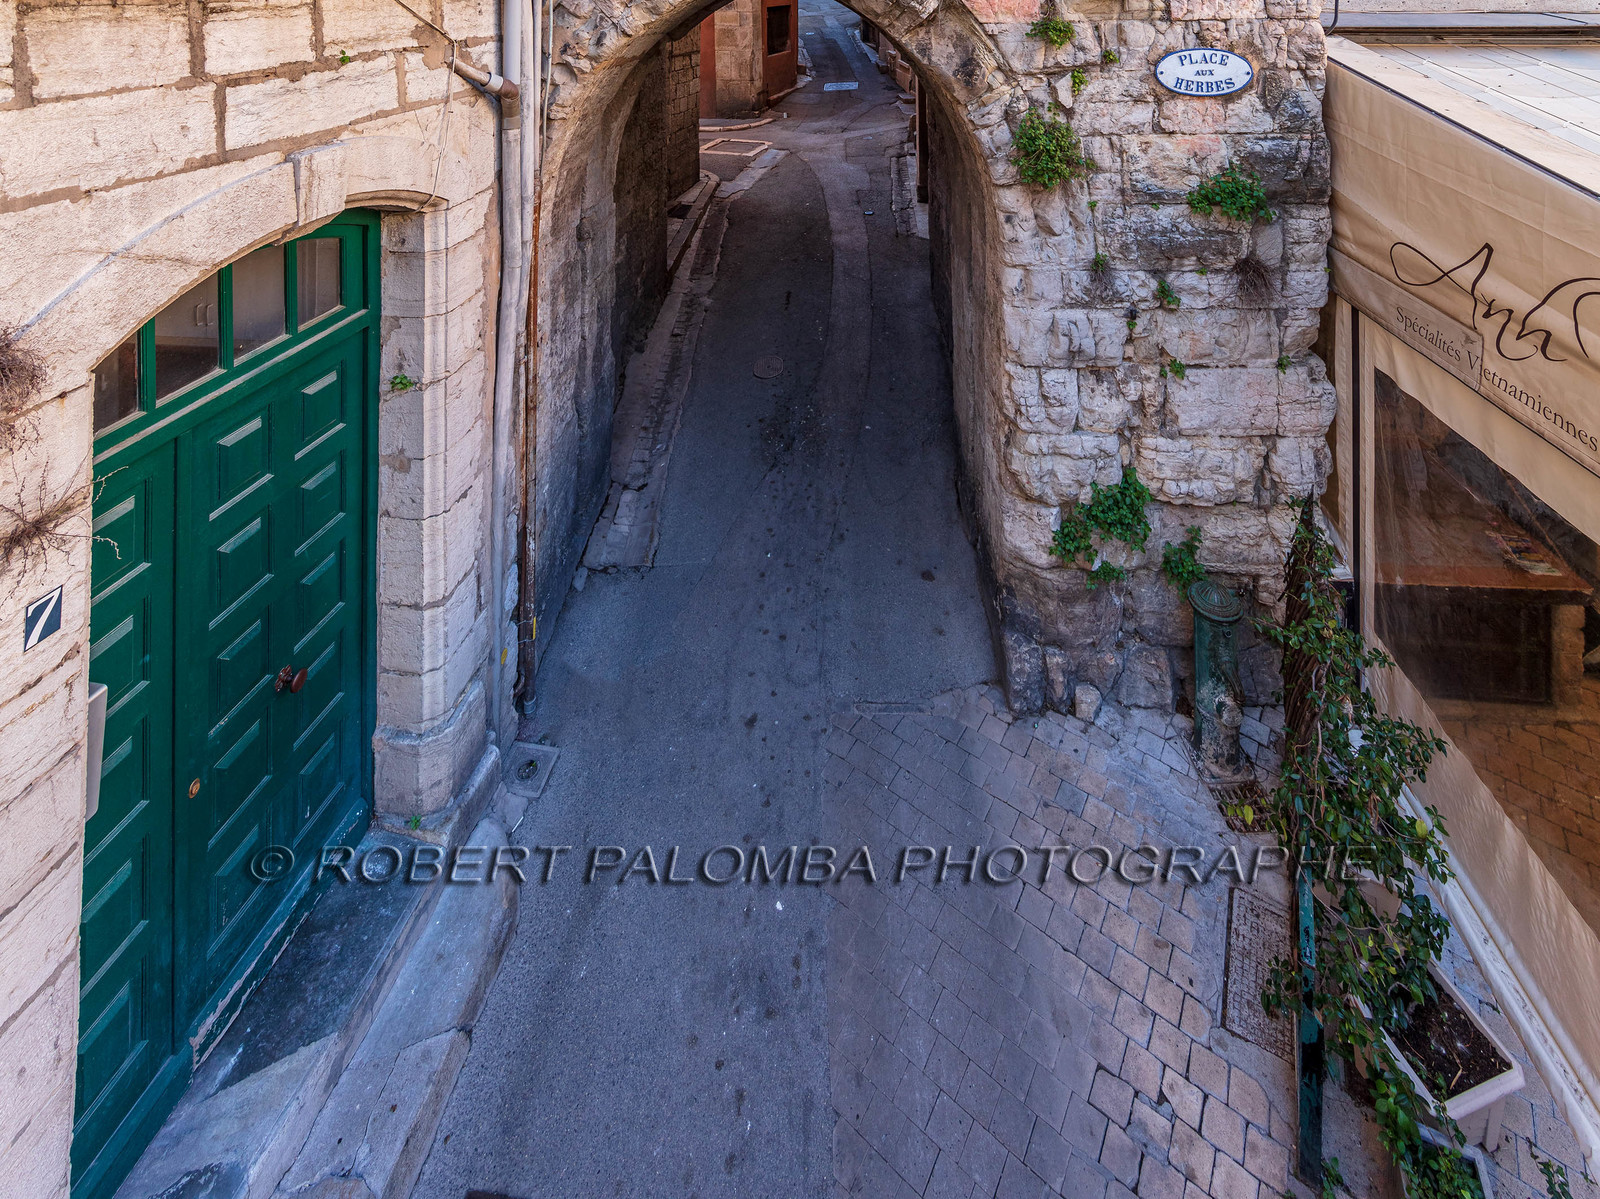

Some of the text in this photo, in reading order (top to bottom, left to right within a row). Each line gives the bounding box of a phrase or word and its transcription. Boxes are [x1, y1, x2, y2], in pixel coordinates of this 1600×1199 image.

[1178, 53, 1229, 66] PLACE
[1173, 77, 1235, 93] HERBES
[1396, 306, 1598, 452] Spécialités Vietnamiennes
[25, 587, 62, 650] 7
